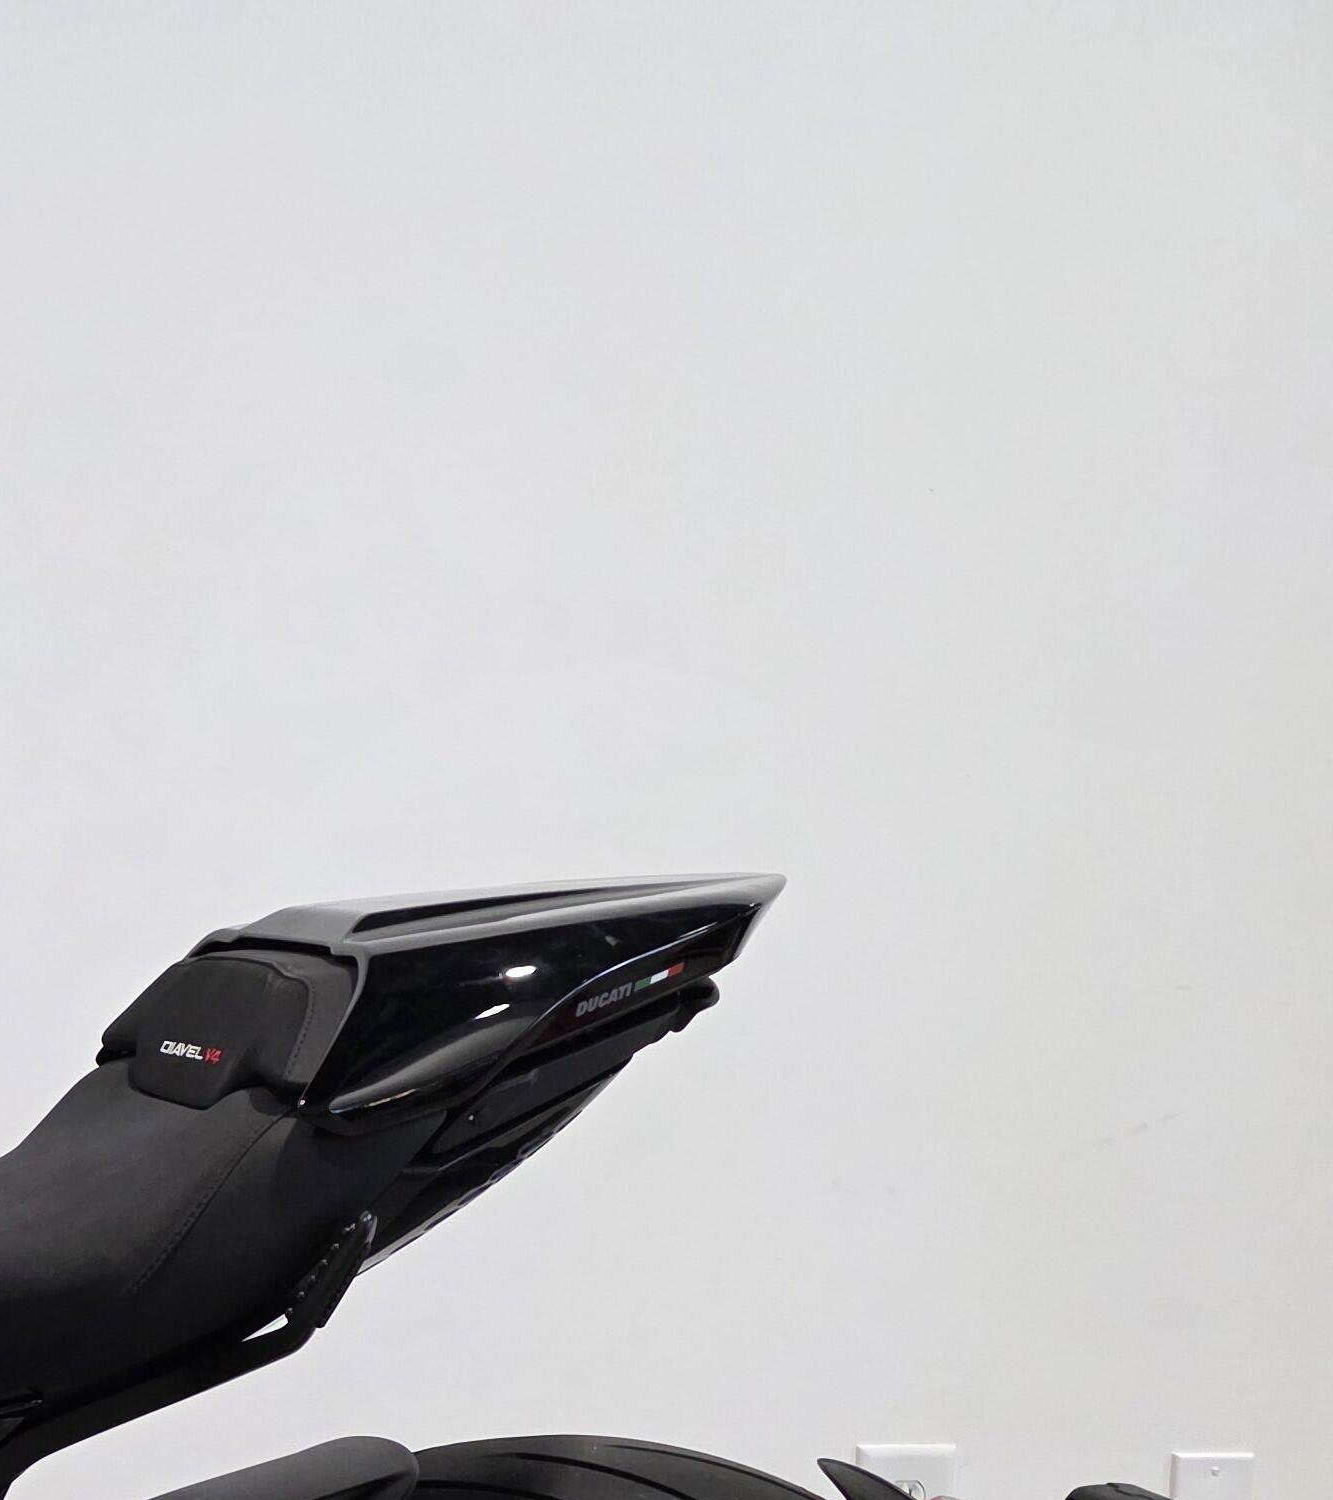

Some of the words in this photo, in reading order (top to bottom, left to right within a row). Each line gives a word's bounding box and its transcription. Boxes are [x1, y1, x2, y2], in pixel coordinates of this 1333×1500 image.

[575, 981, 633, 1018] DUCATI
[159, 1040, 204, 1060] DIAVEL
[204, 1046, 222, 1064] V4
